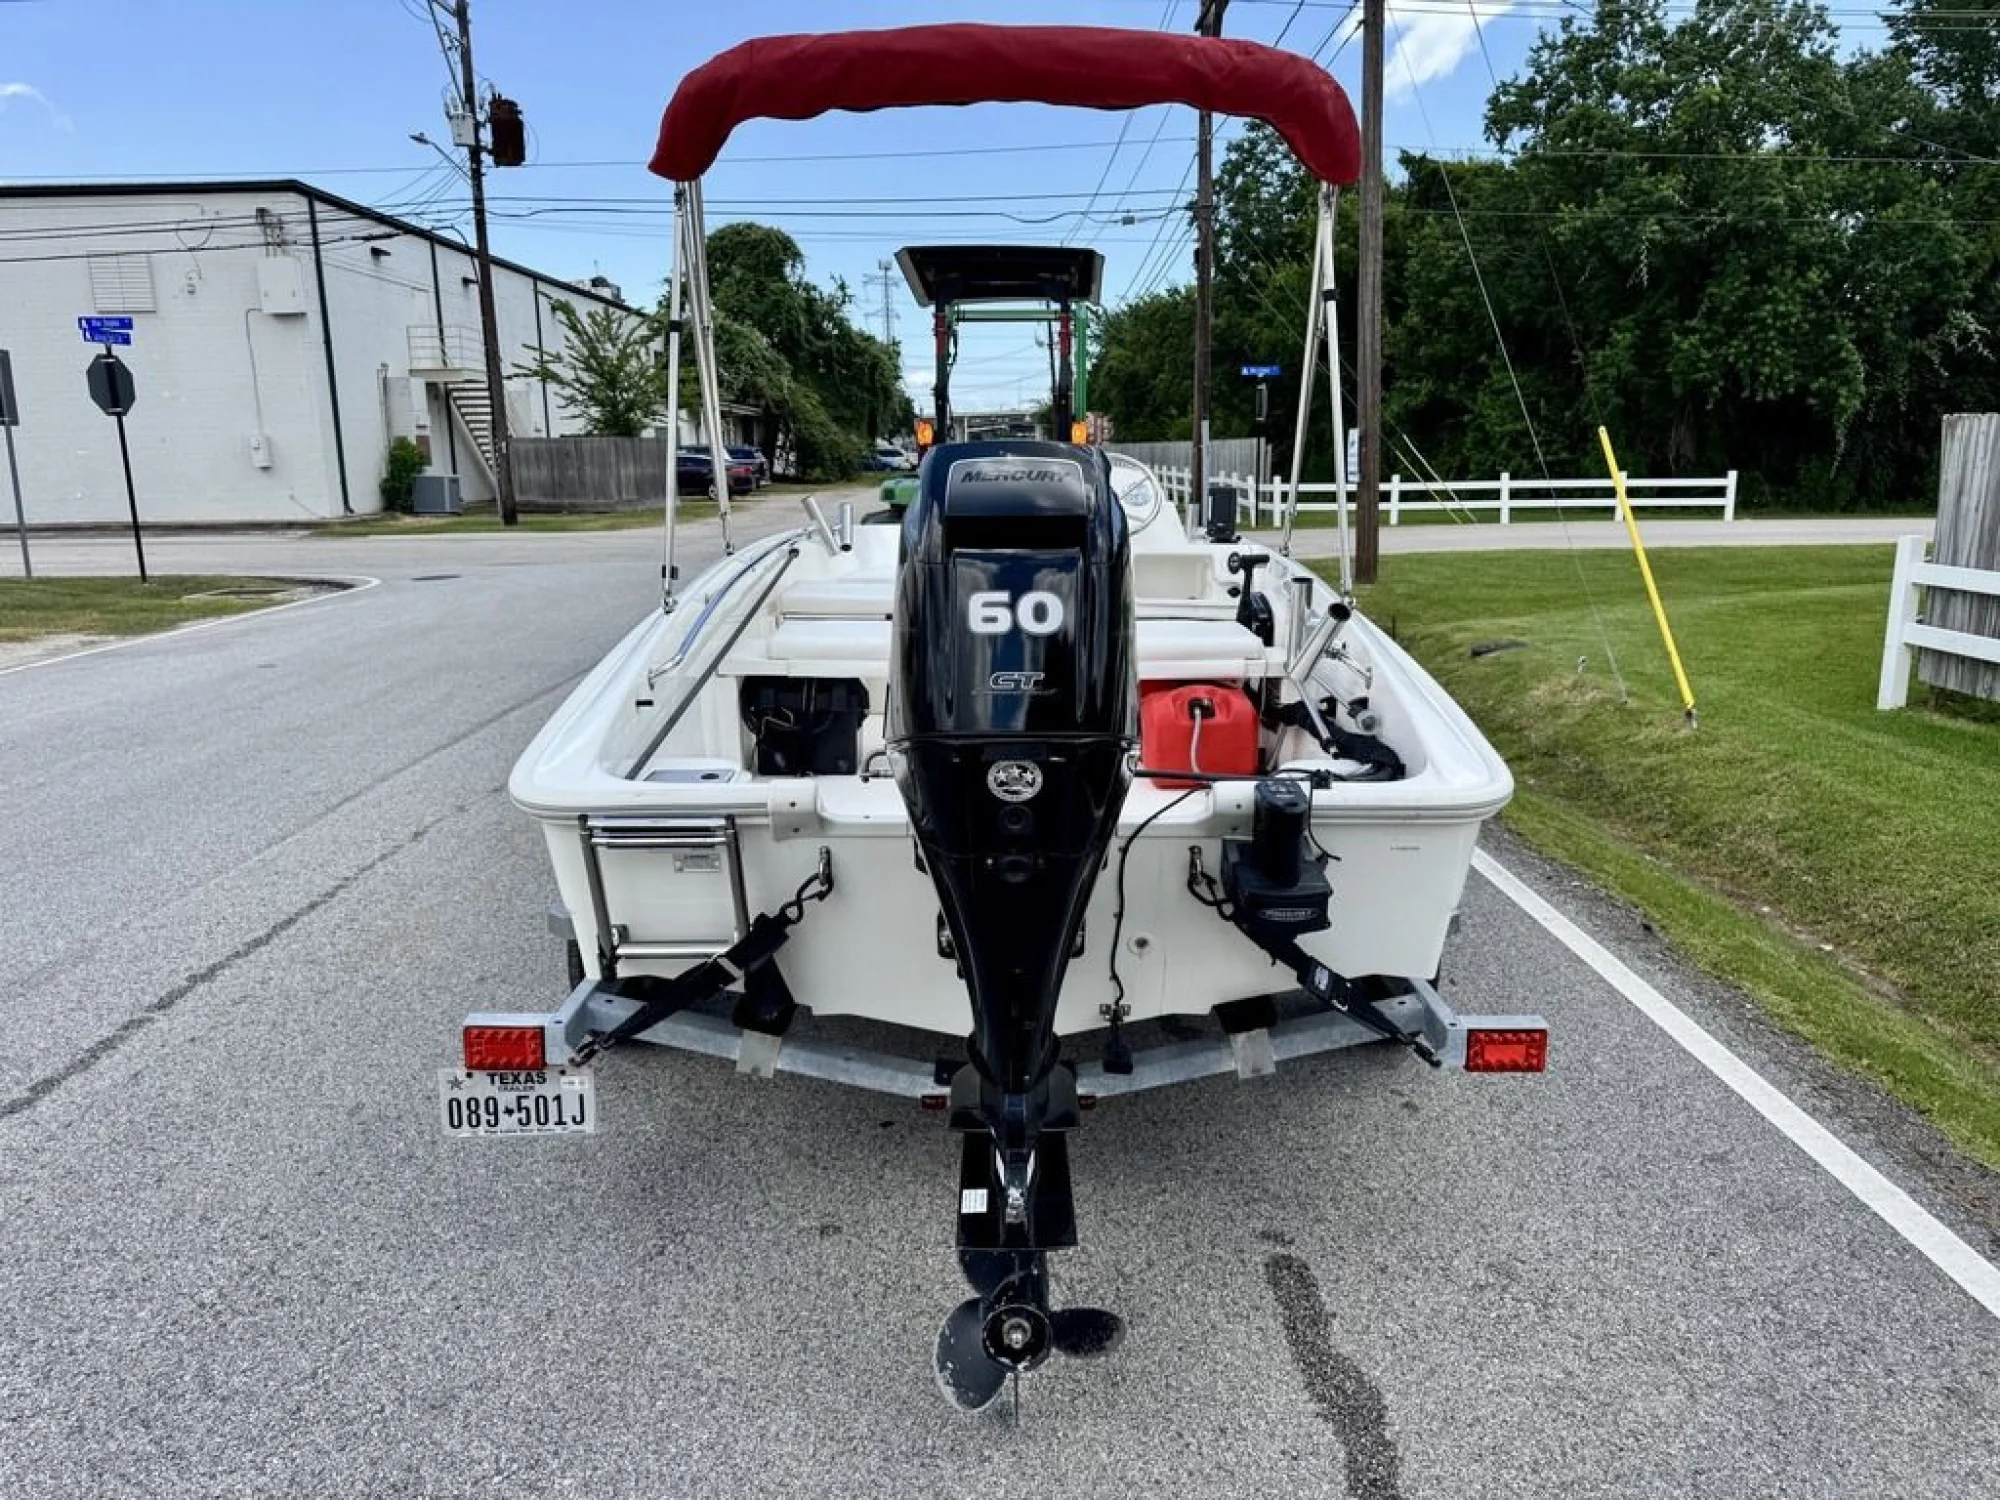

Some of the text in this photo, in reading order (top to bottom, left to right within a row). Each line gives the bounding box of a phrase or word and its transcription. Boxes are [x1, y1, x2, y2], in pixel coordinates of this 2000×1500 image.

[968, 591, 1063, 635] 60
[989, 671, 1045, 689] GT
[486, 1071, 547, 1085] TEXAS
